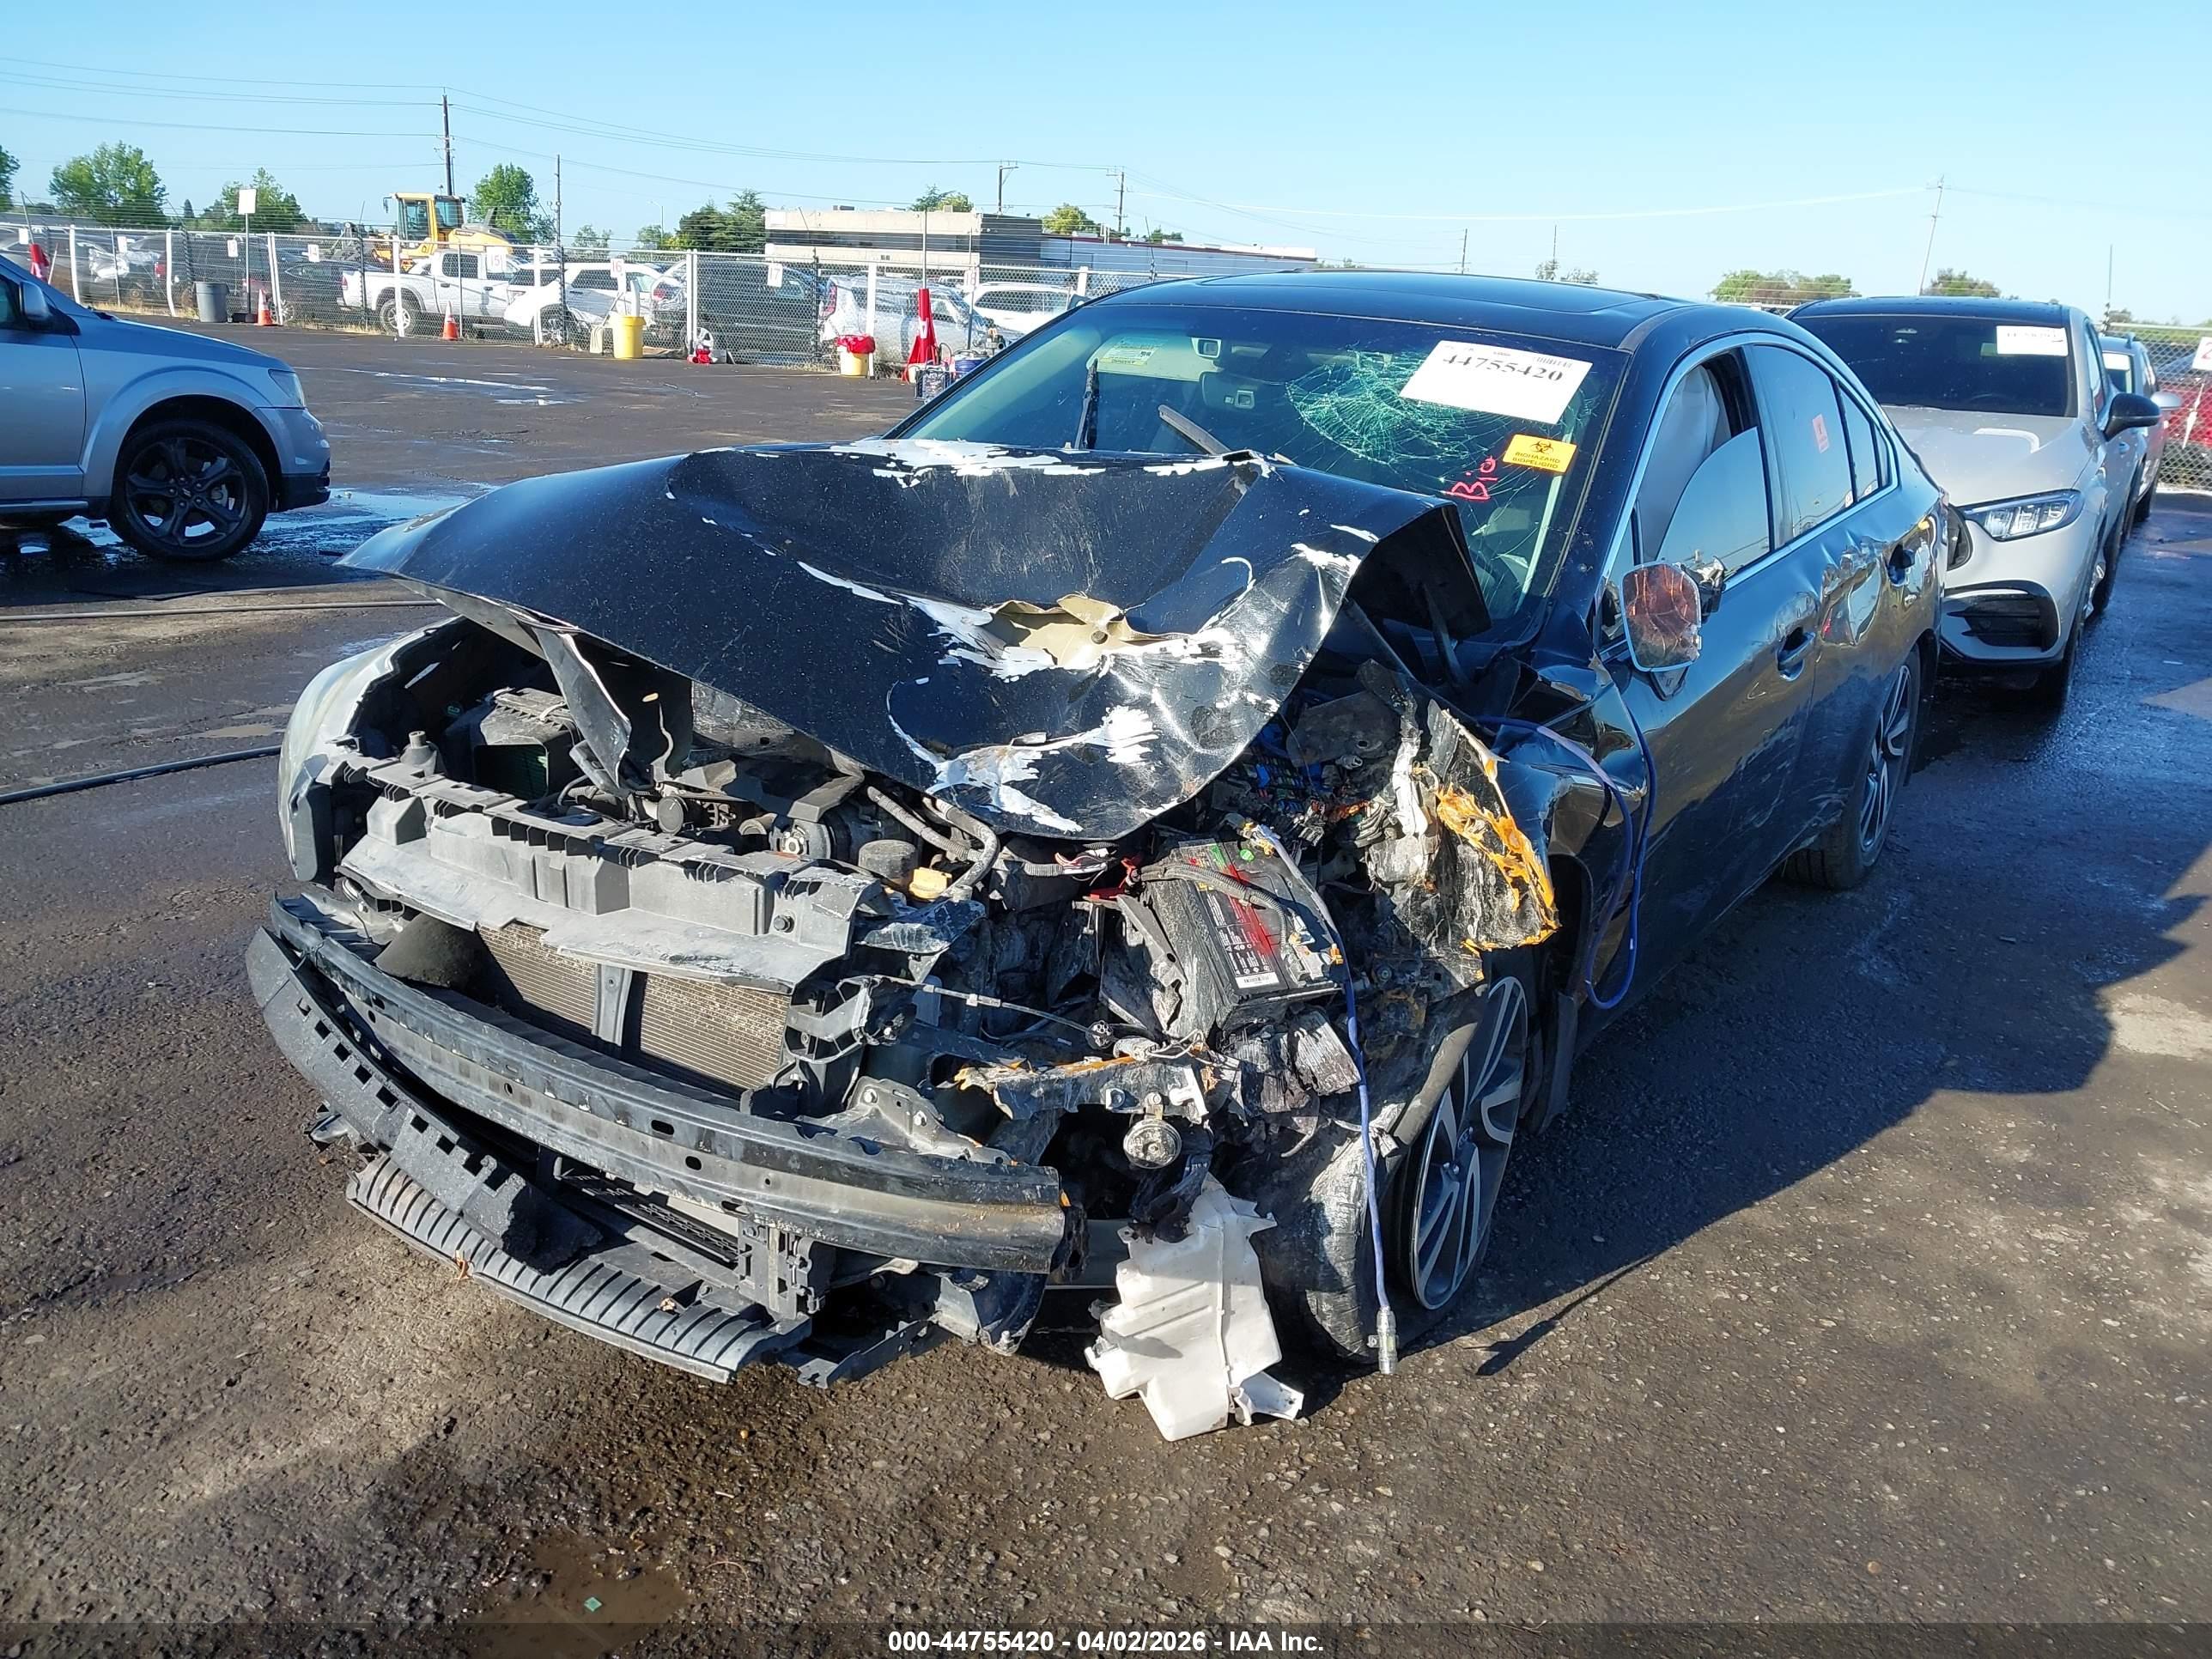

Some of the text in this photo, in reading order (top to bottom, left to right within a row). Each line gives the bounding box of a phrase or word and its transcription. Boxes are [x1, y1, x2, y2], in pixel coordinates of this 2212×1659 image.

[612, 260, 623, 272] 16
[770, 267, 781, 281] 17
[1443, 354, 1564, 381] 44755420
